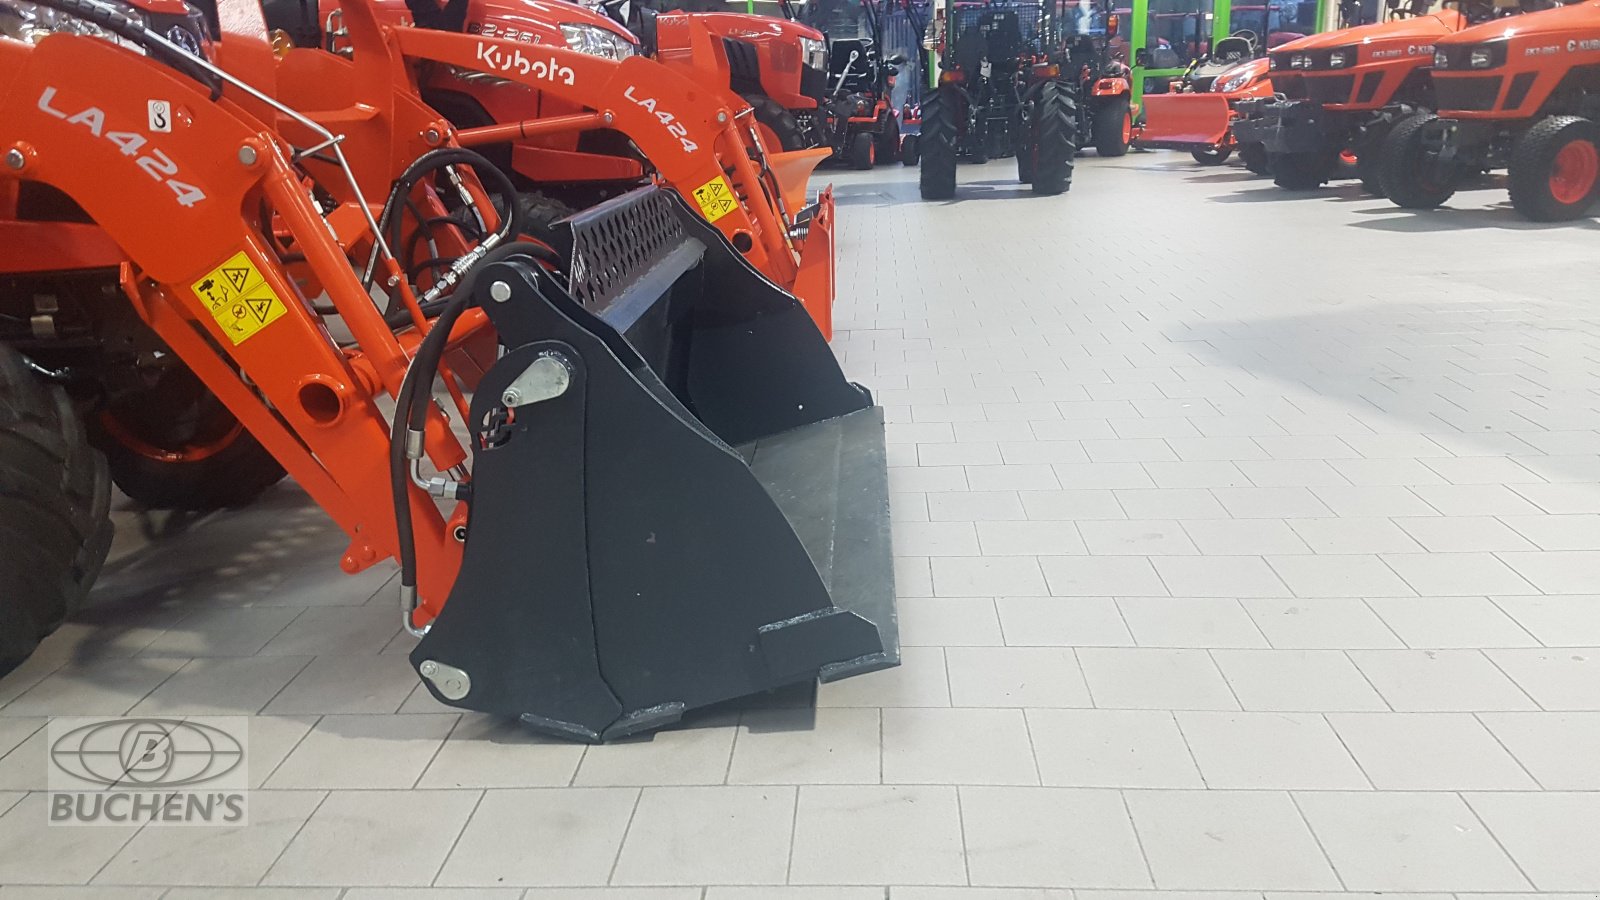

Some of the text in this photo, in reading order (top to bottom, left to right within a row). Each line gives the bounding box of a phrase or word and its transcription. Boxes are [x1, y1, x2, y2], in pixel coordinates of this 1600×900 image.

[477, 42, 575, 85] Kubota
[37, 86, 206, 207] LA424
[624, 85, 698, 153] LA424
